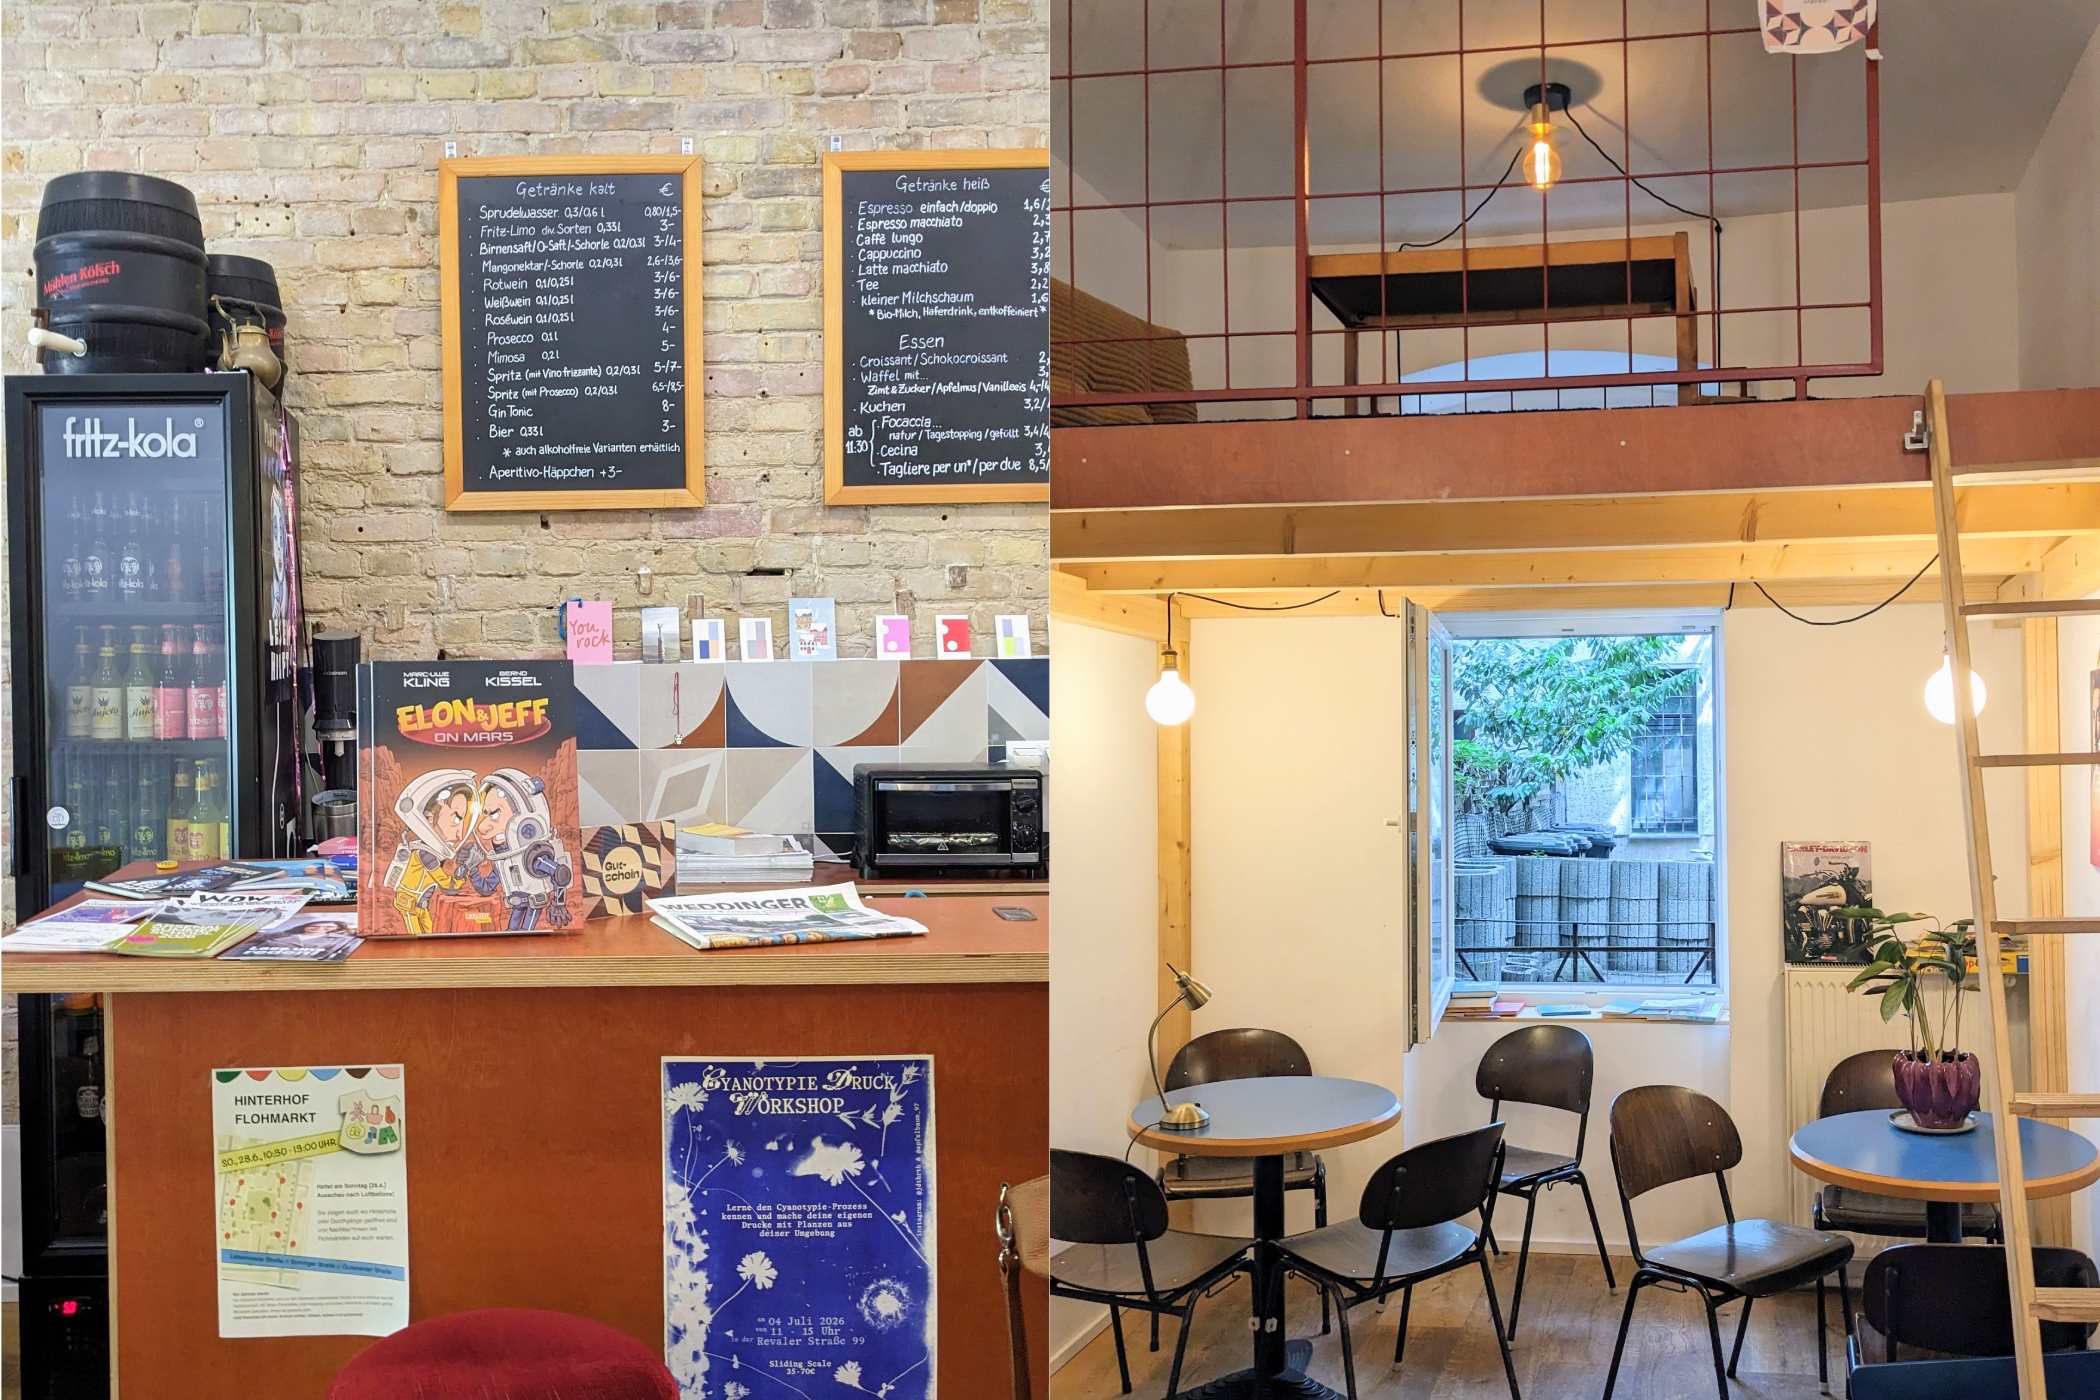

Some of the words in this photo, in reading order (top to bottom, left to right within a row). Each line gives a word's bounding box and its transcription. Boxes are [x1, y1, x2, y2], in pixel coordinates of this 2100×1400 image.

[516, 181, 583, 199] Getränke
[590, 181, 616, 196] kalt
[659, 182, 674, 196] €
[896, 175, 957, 192] Getränke
[963, 177, 990, 190] heiß
[479, 205, 558, 221] Sprudelwasser
[564, 207, 598, 218] 0,3/0,6
[858, 201, 912, 216] Espresso
[920, 200, 998, 215] einfach/doppio
[858, 218, 907, 232] Espresso
[910, 215, 962, 228] macchiato
[480, 225, 535, 238] Fritz-Limo
[556, 224, 592, 235] Sorten
[856, 234, 886, 246] Caffè
[892, 232, 923, 246] lungo
[858, 249, 921, 262] Cappuccino
[858, 263, 888, 276] Latte
[892, 259, 948, 275] macchiato
[483, 278, 528, 291] Rotwein
[857, 279, 879, 291] Tee
[484, 296, 531, 309] Weißwein
[861, 294, 899, 306] kleiner
[902, 291, 974, 304] Milchschaum
[485, 313, 532, 326] Roséwein
[487, 331, 534, 345] Prosecco
[900, 334, 944, 350] Essen
[487, 352, 525, 364] Mimosa
[860, 356, 912, 368] Croissant
[920, 352, 1008, 365] Schokocroissant
[487, 368, 521, 383] Spritz
[525, 369, 541, 380] (mit
[861, 370, 900, 382] Waffel
[487, 386, 518, 401] Spritz
[522, 387, 537, 399] (mit
[539, 386, 579, 398] Prosecco)
[488, 405, 506, 418] Gin
[509, 405, 533, 417] Tonic
[860, 401, 906, 414] Kuchen
[490, 425, 514, 439] Bier
[848, 426, 863, 437] ab
[889, 430, 917, 440] natur
[926, 429, 982, 443] Tagestopping
[515, 445, 536, 456] auch
[538, 443, 591, 455] alkoholfreie
[592, 442, 636, 454] Varianten
[639, 442, 680, 453] erhältlich
[880, 444, 918, 457] Cecina
[490, 465, 594, 480] Aperitivo-Häppchen
[880, 461, 930, 479] Tagliere
[933, 463, 951, 477] per
[1000, 456, 1021, 471] due
[570, 620, 598, 636] You
[576, 630, 610, 648] rock
[404, 678, 450, 687] KLING
[486, 677, 542, 686] KISSEL
[434, 732, 459, 742] ON
[464, 732, 513, 742] MARS
[605, 862, 626, 870] Gut-
[702, 1064, 817, 1092] CYANOTYPIE
[822, 1065, 896, 1091] DRUCK
[235, 1094, 310, 1105] HINTERHOF
[730, 1092, 844, 1116] WORKSHOP
[235, 1113, 316, 1124] FLOHMARKT
[777, 1203, 867, 1212] Cyanotypie-Prozess
[795, 1230, 835, 1238] Umgebung
[768, 1317, 782, 1325] 04
[787, 1316, 812, 1326] Juli
[820, 1317, 844, 1326] 2026
[821, 1327, 840, 1335] Uhr
[757, 1337, 802, 1345] Revaler
[808, 1337, 846, 1345] Straße
[769, 1360, 803, 1368] Sliding
